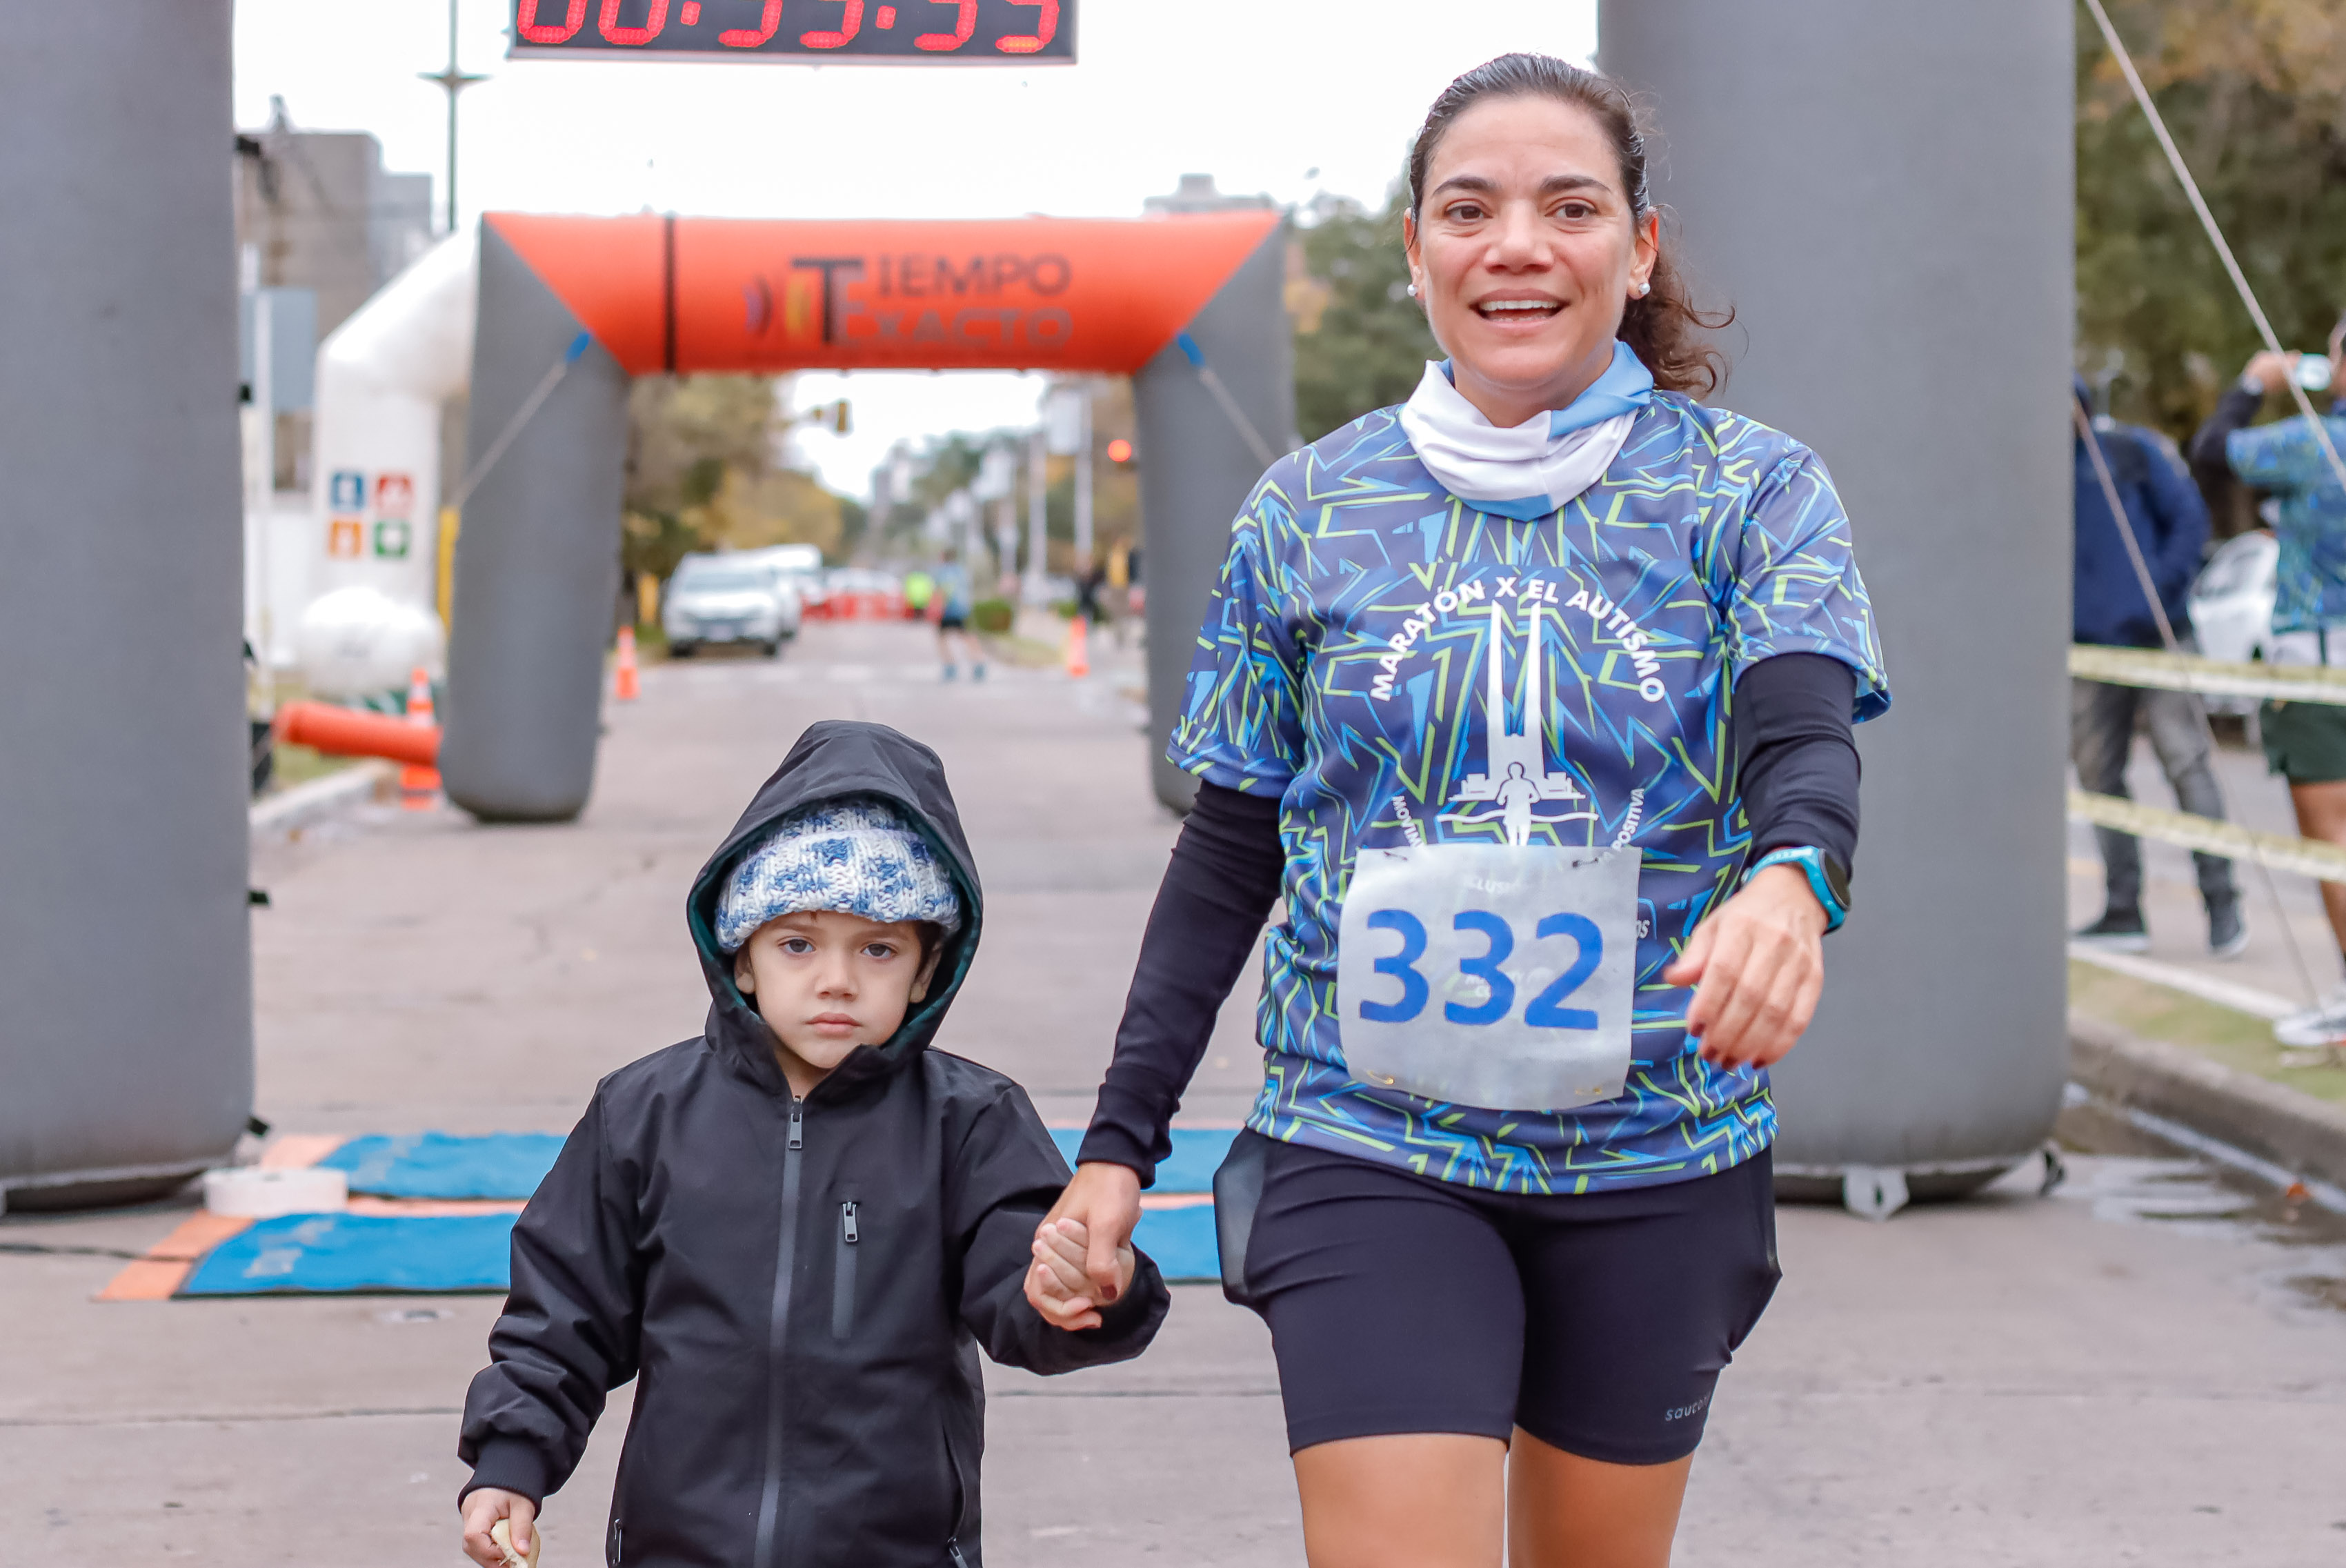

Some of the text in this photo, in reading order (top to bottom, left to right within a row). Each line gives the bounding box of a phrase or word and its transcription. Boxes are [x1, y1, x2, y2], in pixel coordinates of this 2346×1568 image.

[789, 251, 1073, 344] TIEMPO
[1370, 576, 1666, 703] MARATÓN X EL AUTISMO
[1391, 795, 1426, 850] MOVIM
[1611, 788, 1645, 853] POSITIVA
[1360, 909, 1604, 1031] 332
